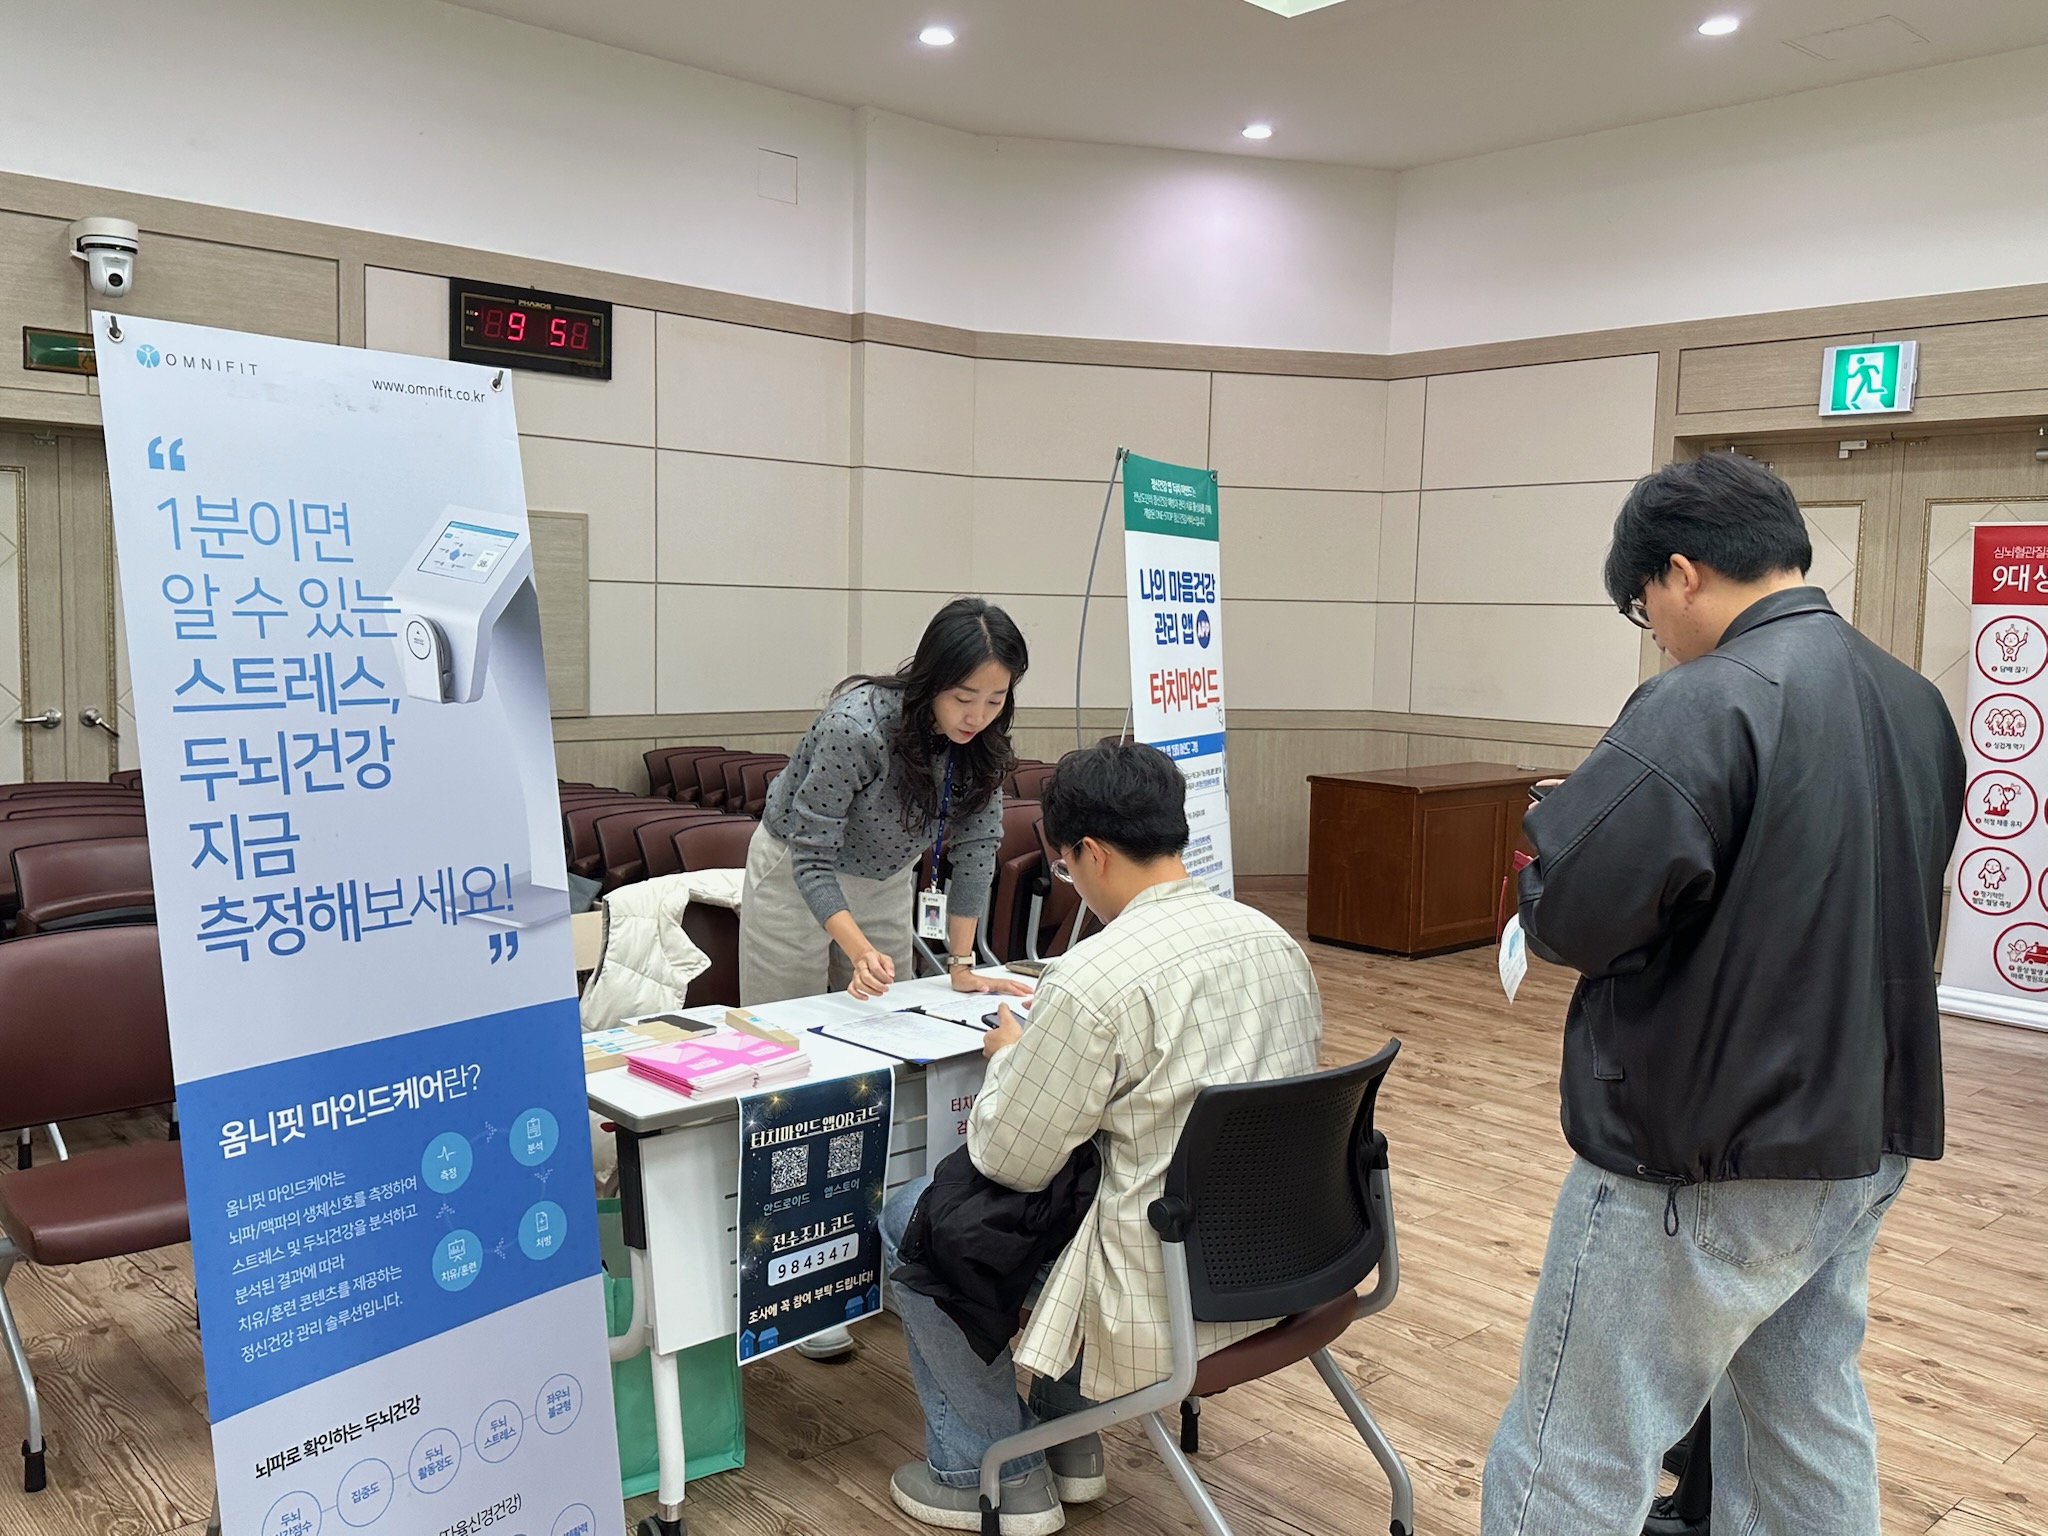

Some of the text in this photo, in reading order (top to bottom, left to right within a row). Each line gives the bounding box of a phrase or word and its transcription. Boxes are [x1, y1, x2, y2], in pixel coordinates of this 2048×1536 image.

[518, 299, 552, 310] PHAROS
[165, 353, 258, 376] OMNIFIT
[371, 379, 486, 403] www.omnifit.co.kr
[157, 495, 354, 564] 1분이면
[1140, 568, 1216, 604] 나의 마음건강
[1992, 563, 2031, 593] 9대
[162, 573, 401, 640] 알 수 있는
[1154, 611, 1179, 645] 관리
[1181, 612, 1195, 645] 앱
[172, 652, 400, 716] 스트레스,
[1149, 666, 1220, 714] 터치마인드
[179, 725, 396, 802] 두뇌건강
[189, 811, 301, 881] 지금
[197, 862, 515, 963] 측정해보세요!
[218, 1063, 481, 1160] 옴니핏 마인드케어란?
[951, 1094, 979, 1112] 터치
[527, 1140, 545, 1156] 분석
[440, 1166, 458, 1181] 측정
[823, 1178, 860, 1199] 앱스토어
[225, 1170, 347, 1219] 옴니핏 마인드케어는
[229, 1175, 418, 1245] 뇌파/맥파의 생체신호를 측정하여
[763, 1192, 811, 1217] 안드로이드
[232, 1203, 418, 1276] 스트레스 및 두뇌건강을 분석하고
[535, 1234, 553, 1249] 처방
[772, 1212, 856, 1253] 전수조사 코드
[440, 1261, 478, 1282] 치유/훈련
[778, 1242, 850, 1279] 984347
[234, 1253, 345, 1305] 분석된 결과에 따라
[238, 1265, 403, 1332] 치유/훈련 콘텐츠를 제공하는
[748, 1269, 874, 1324] 조사에 꼭 참여 부탁 드립니다!
[241, 1291, 404, 1363] 정신건강 관리 솔루션입니다.
[546, 1385, 571, 1405] 좌우뇌
[547, 1399, 572, 1419] 불균형
[255, 1394, 421, 1479] 뇌파로 확인하는 두뇌건강
[484, 1427, 517, 1449] 스트레스
[490, 1415, 508, 1432] 두뇌
[417, 1455, 454, 1480] 활동정도
[425, 1444, 444, 1462] 두뇌
[350, 1481, 382, 1504] 집중도
[280, 1507, 301, 1527] 두뇌
